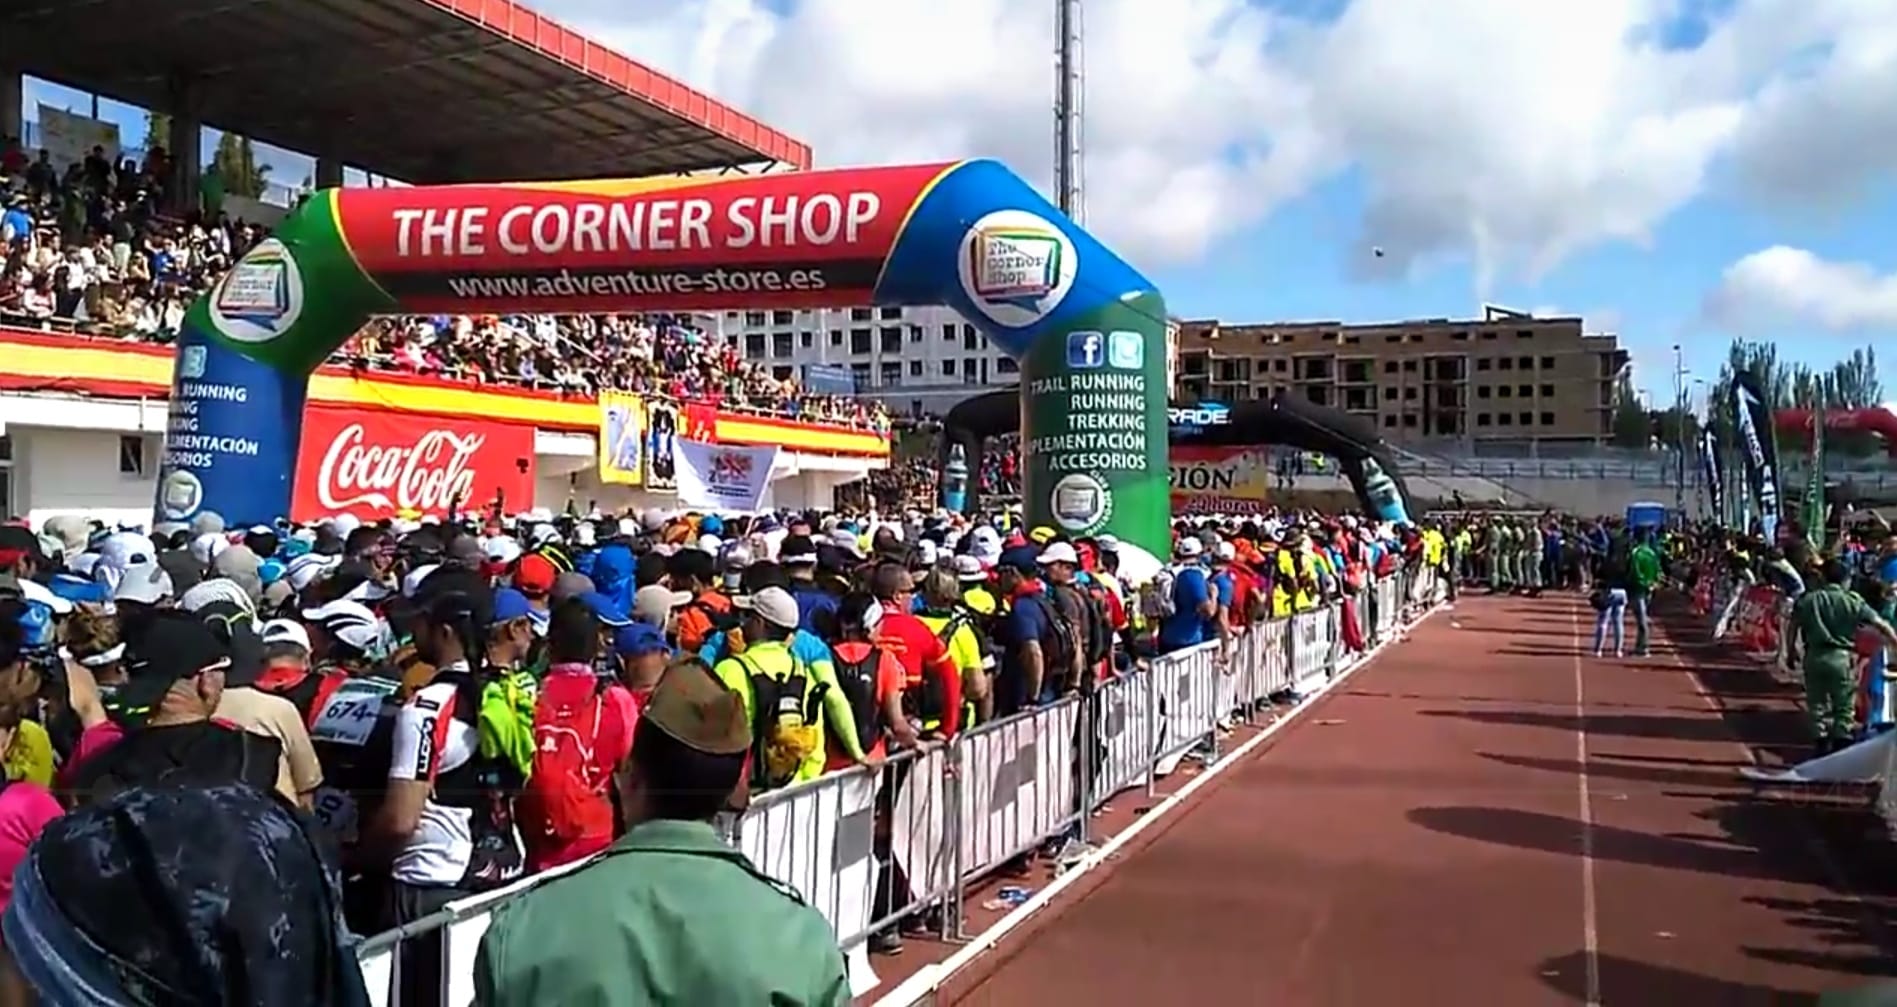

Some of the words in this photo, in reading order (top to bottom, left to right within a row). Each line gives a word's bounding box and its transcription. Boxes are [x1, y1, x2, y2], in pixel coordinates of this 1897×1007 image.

[393, 207, 488, 256] THE
[498, 199, 713, 254] CORNER
[726, 191, 880, 249] SHOP
[448, 266, 826, 299] www.adventure-store.es
[1030, 376, 1067, 395] TRAIL
[1070, 373, 1145, 392] RUNNING
[1070, 393, 1146, 411] RUNNING
[1067, 413, 1146, 431] TREKKING
[1167, 407, 1230, 425] RADE
[1048, 452, 1147, 471] ACCESORIOS
